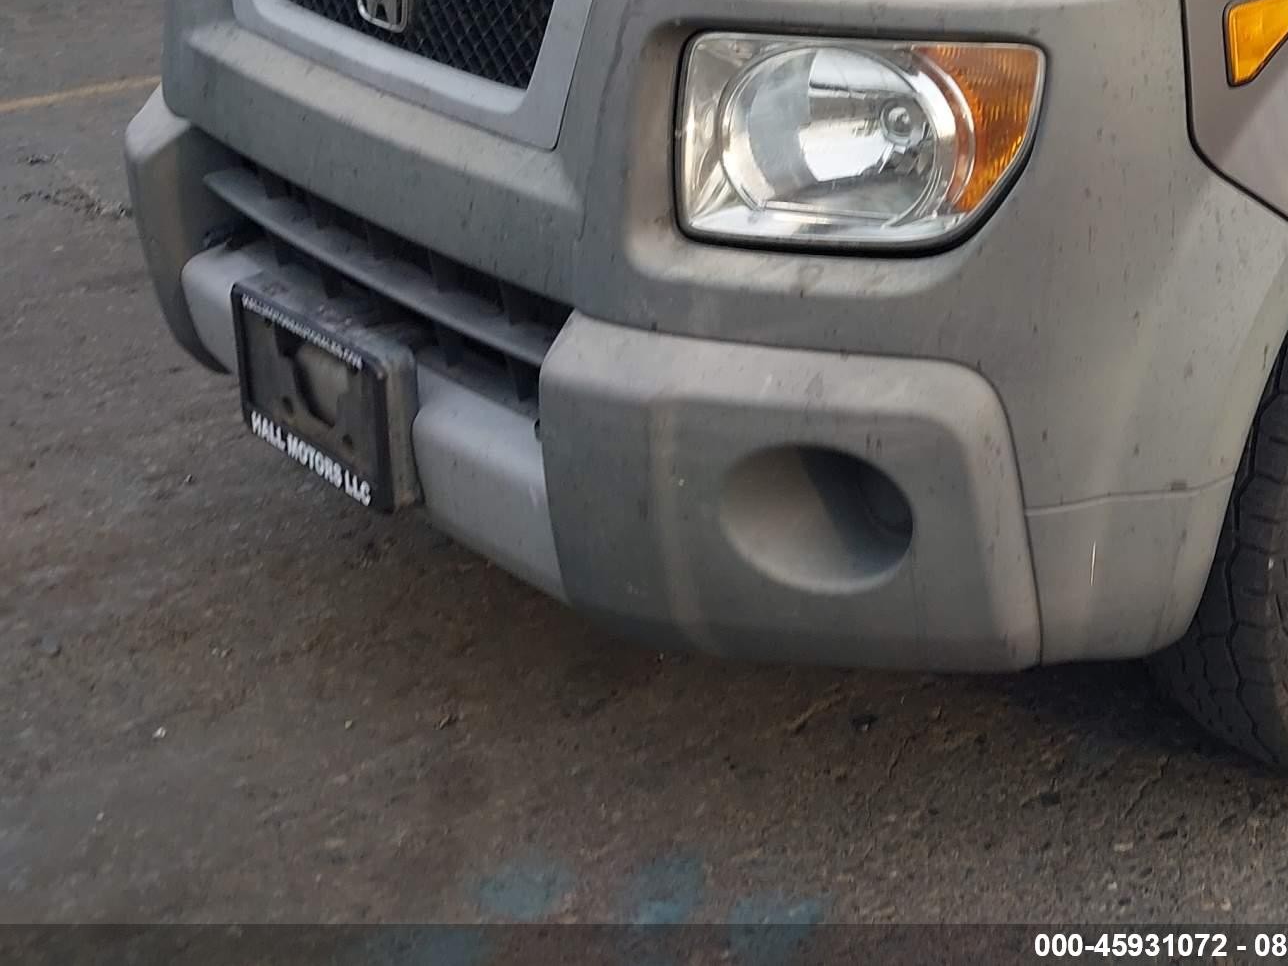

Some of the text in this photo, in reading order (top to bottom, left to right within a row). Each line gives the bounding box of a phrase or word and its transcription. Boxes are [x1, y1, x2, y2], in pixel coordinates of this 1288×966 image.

[251, 410, 371, 506] HALL MOTORS LLC
